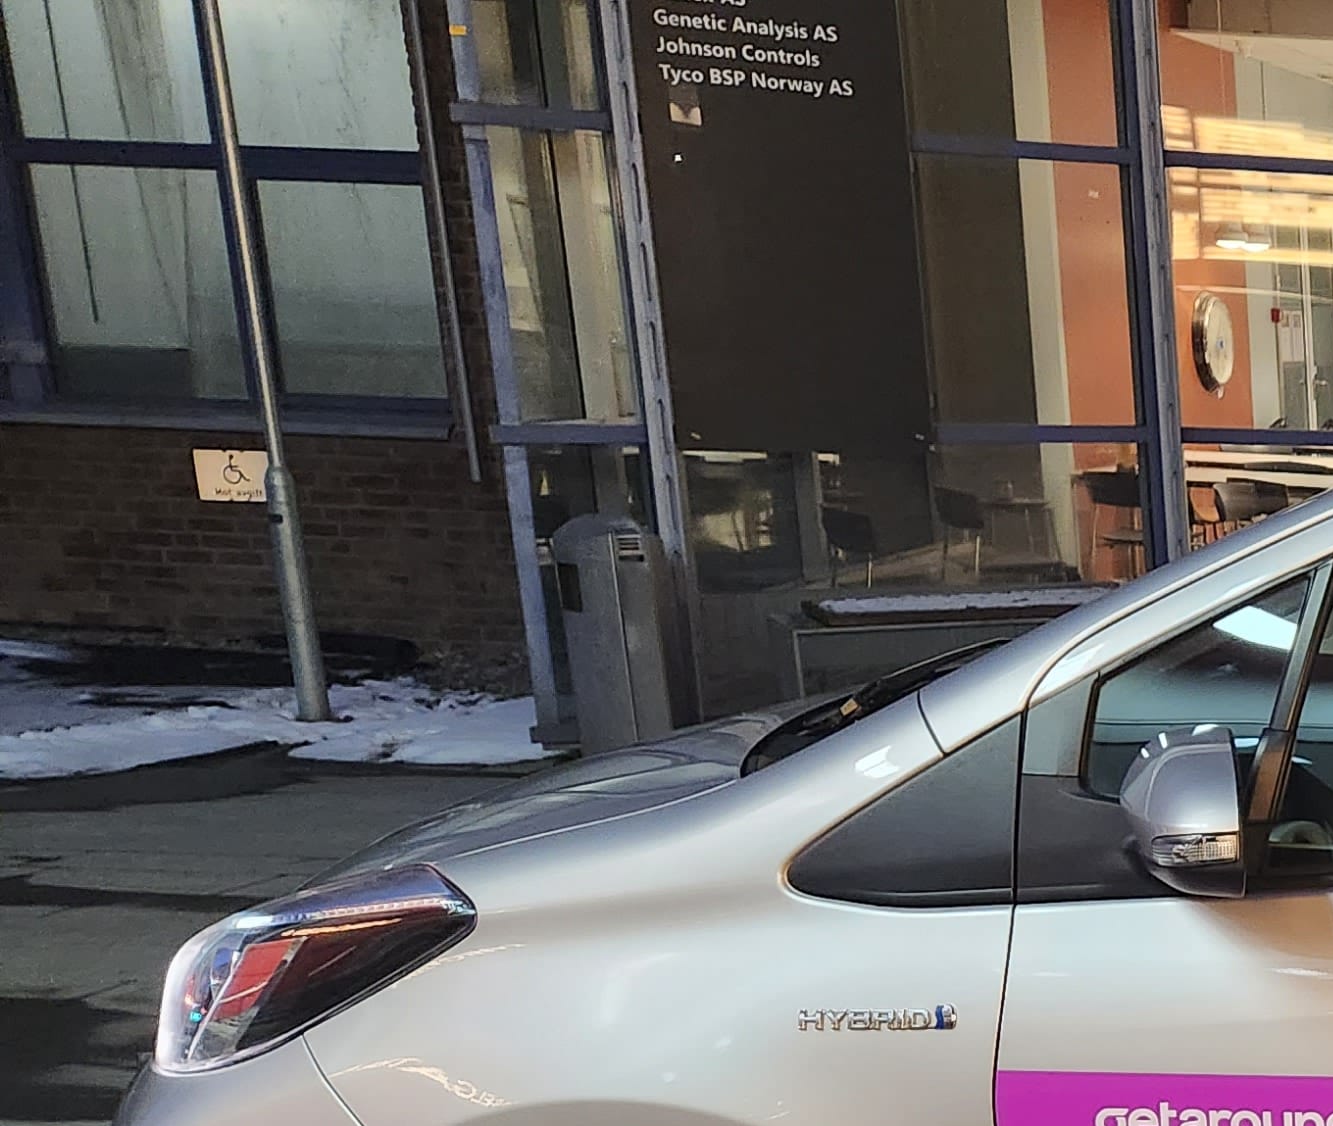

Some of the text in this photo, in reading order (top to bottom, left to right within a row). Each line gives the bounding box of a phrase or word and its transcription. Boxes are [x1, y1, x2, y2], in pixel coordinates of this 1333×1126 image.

[653, 8, 838, 42] Genetic Analysis AS
[656, 36, 820, 67] Johnson Controls
[658, 63, 854, 98] Tyco BSP Norway AS
[797, 1008, 932, 1032] HYBRID
